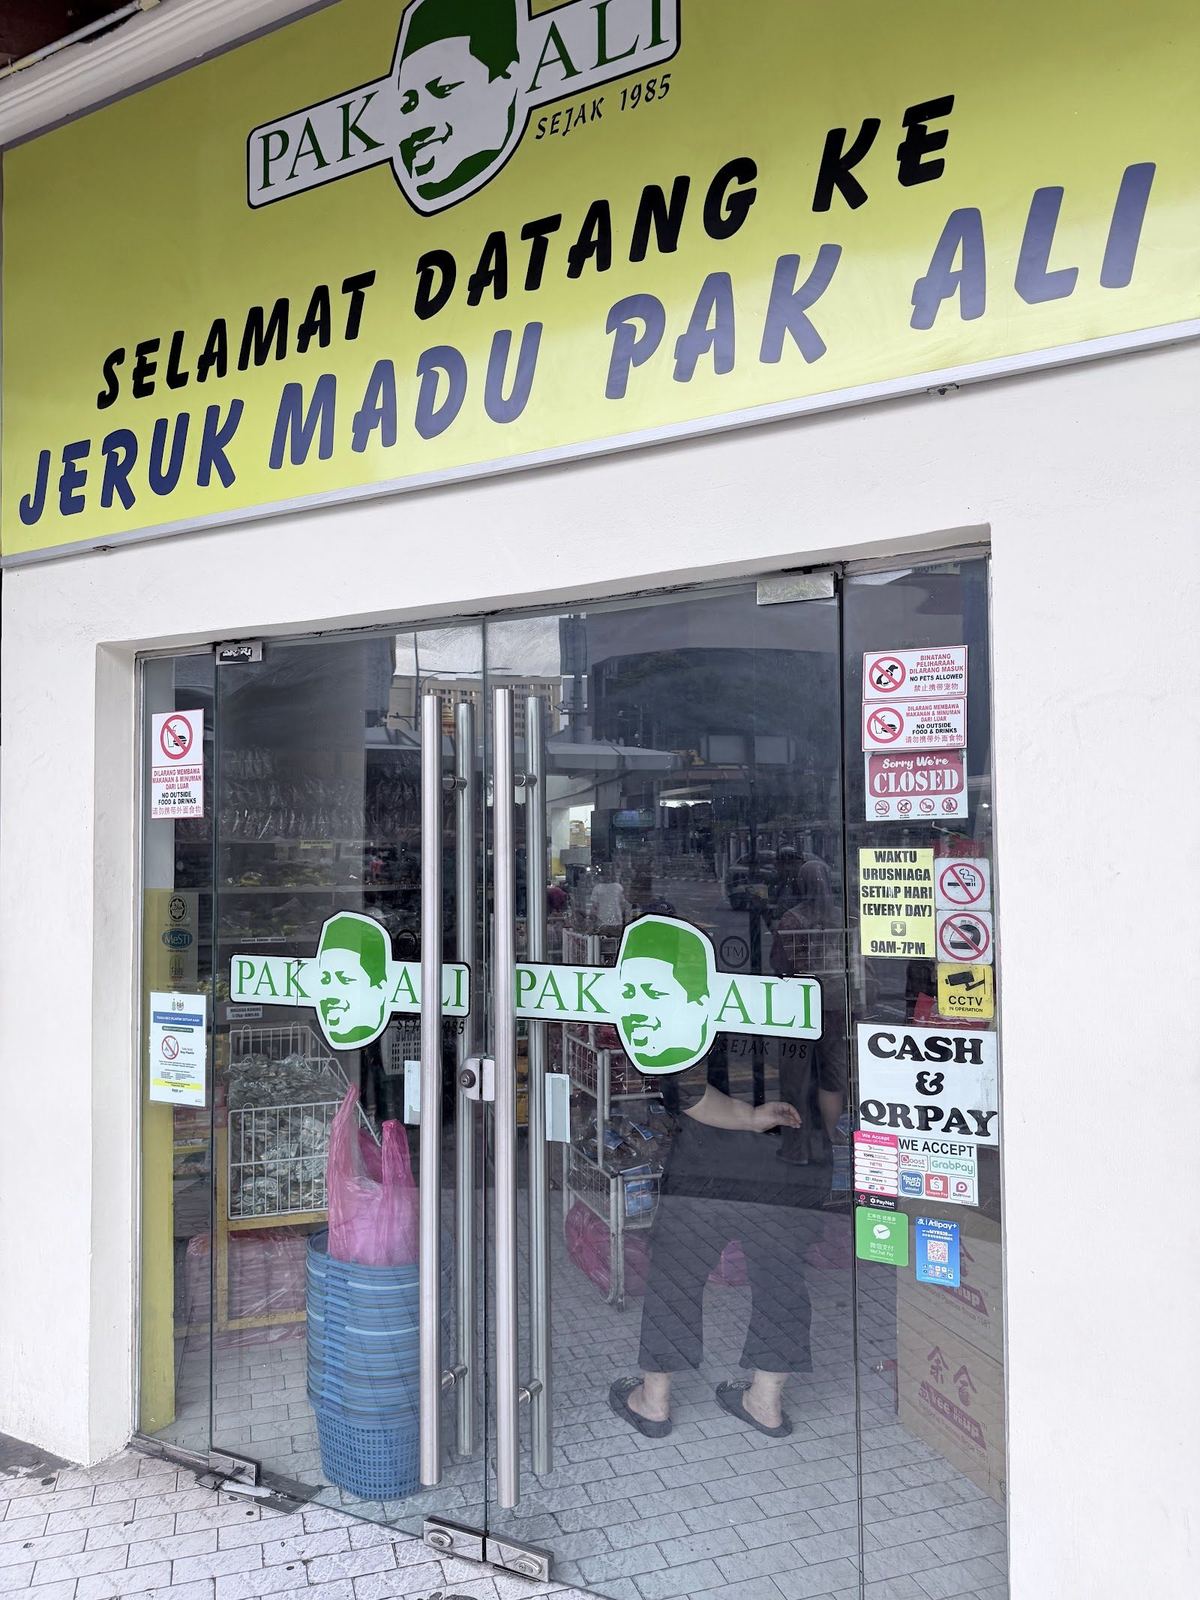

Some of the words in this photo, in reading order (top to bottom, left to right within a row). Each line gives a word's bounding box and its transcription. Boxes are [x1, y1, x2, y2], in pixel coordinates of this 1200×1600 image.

[257, 94, 386, 191] PAK
[526, 0, 671, 92] ALI
[534, 97, 605, 141] SEJAK
[619, 74, 672, 112] 1985
[97, 269, 377, 409] SELAMAT
[414, 156, 758, 320] DATANG
[811, 94, 955, 213] KE
[19, 399, 244, 525] JERUK
[269, 321, 544, 470] MADU
[605, 243, 843, 400] PAK
[909, 162, 1157, 330] ALI
[916, 659, 955, 668] PELIHARAAN
[920, 653, 951, 661] BINATANG
[909, 667, 940, 675] DILARANG
[941, 665, 964, 673] MASUK
[935, 673, 964, 681] ALLOWED
[907, 704, 932, 712] DILARANG
[882, 758, 914, 770] Sorry
[916, 756, 950, 767] We're
[153, 769, 176, 777] DILARANG
[873, 769, 959, 794] CLOSED
[170, 790, 192, 798] OUTSIDE
[158, 798, 172, 806] FOOD
[177, 797, 197, 805] DRINKS
[874, 850, 918, 864] WAKTU
[862, 868, 932, 882] URUSNIAGA
[861, 886, 901, 900] SETIAP
[903, 886, 933, 900] HARI
[862, 904, 902, 918] (EVERY
[905, 904, 933, 918] DAY)
[870, 940, 926, 956] 9AM-7PM
[235, 960, 312, 998] PAK
[390, 966, 467, 1008] AI
[516, 969, 611, 1013] PAK
[714, 979, 817, 1031] ALI
[948, 995, 984, 1007] CCTV
[954, 1006, 984, 1014] OPERATION
[720, 1038, 770, 1056] SEJAK
[867, 1032, 984, 1065] CASH
[915, 1071, 945, 1096] &
[859, 1099, 998, 1137] QRPAY
[898, 1138, 919, 1152] WE
[922, 1140, 975, 1158] ACCEPT
[931, 1160, 974, 1175] GrabPay
